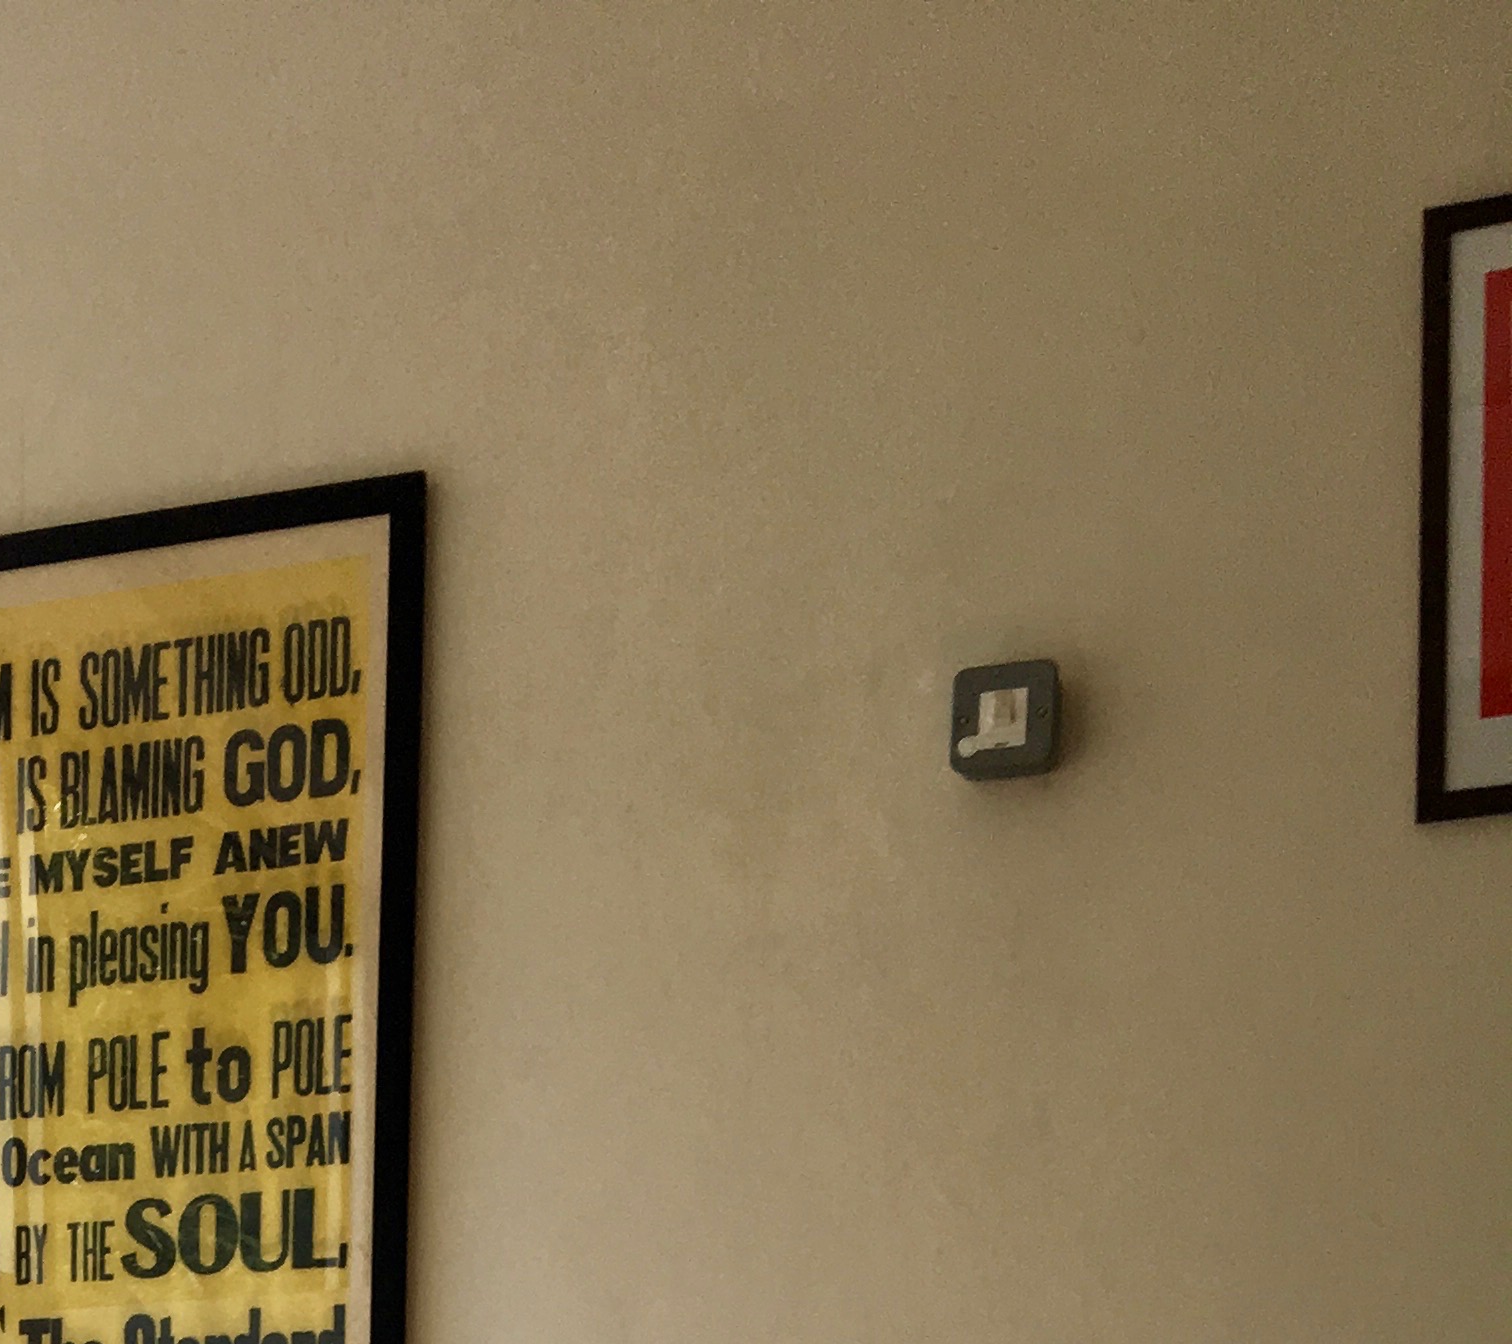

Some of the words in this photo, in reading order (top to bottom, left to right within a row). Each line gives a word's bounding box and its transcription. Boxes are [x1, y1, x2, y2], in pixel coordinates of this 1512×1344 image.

[30, 655, 60, 738] IS
[78, 627, 270, 729] SOMETHING
[283, 616, 360, 705] ODD,
[16, 755, 46, 835] IS
[59, 736, 206, 830] BLAMING
[223, 718, 360, 807] GOD,
[28, 836, 194, 897] MYSELF
[213, 819, 349, 876] ANEW
[26, 919, 55, 993] in
[68, 901, 209, 1007] pleasing
[222, 884, 353, 974] YOU.
[89, 1031, 171, 1113] POLE
[186, 1026, 251, 1105] to
[272, 1014, 352, 1099] POLE
[1, 1137, 135, 1188] Ocean
[150, 1123, 229, 1178] WITH
[240, 1120, 257, 1172] A
[266, 1111, 351, 1169] SPAN
[16, 1222, 48, 1285] BY
[68, 1219, 114, 1283] THE
